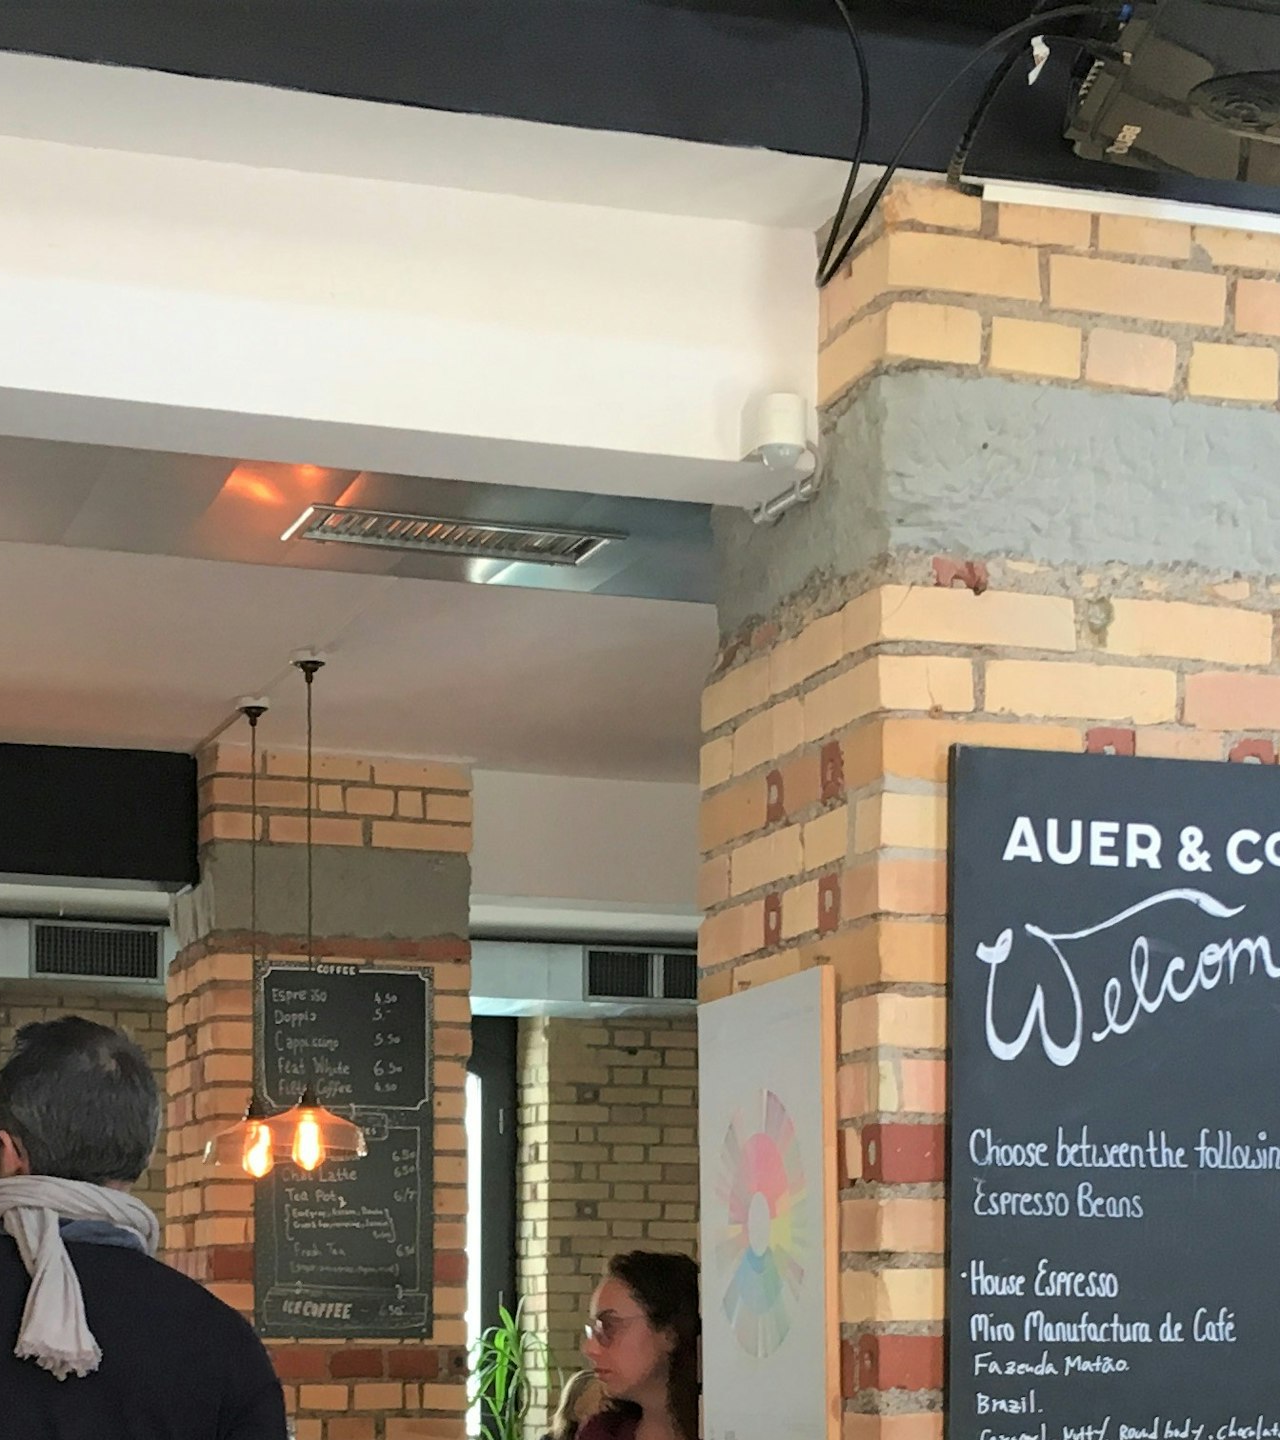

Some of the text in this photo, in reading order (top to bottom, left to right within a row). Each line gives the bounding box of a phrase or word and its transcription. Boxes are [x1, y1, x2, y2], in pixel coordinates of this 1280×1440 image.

[1002, 816, 1162, 870] AUER
[1177, 825, 1213, 873] &
[317, 965, 356, 975] COFFEE
[274, 1009, 317, 1027] Doppio
[969, 1127, 1049, 1167] Choose
[1057, 1125, 1146, 1168] between
[1146, 1130, 1189, 1169] the
[974, 1178, 1144, 1218] Espresso Beans
[970, 1258, 1119, 1298] House Espresso
[970, 1307, 1237, 1343] Miro Manufactura de Café
[974, 1351, 1058, 1376] Fazenda
